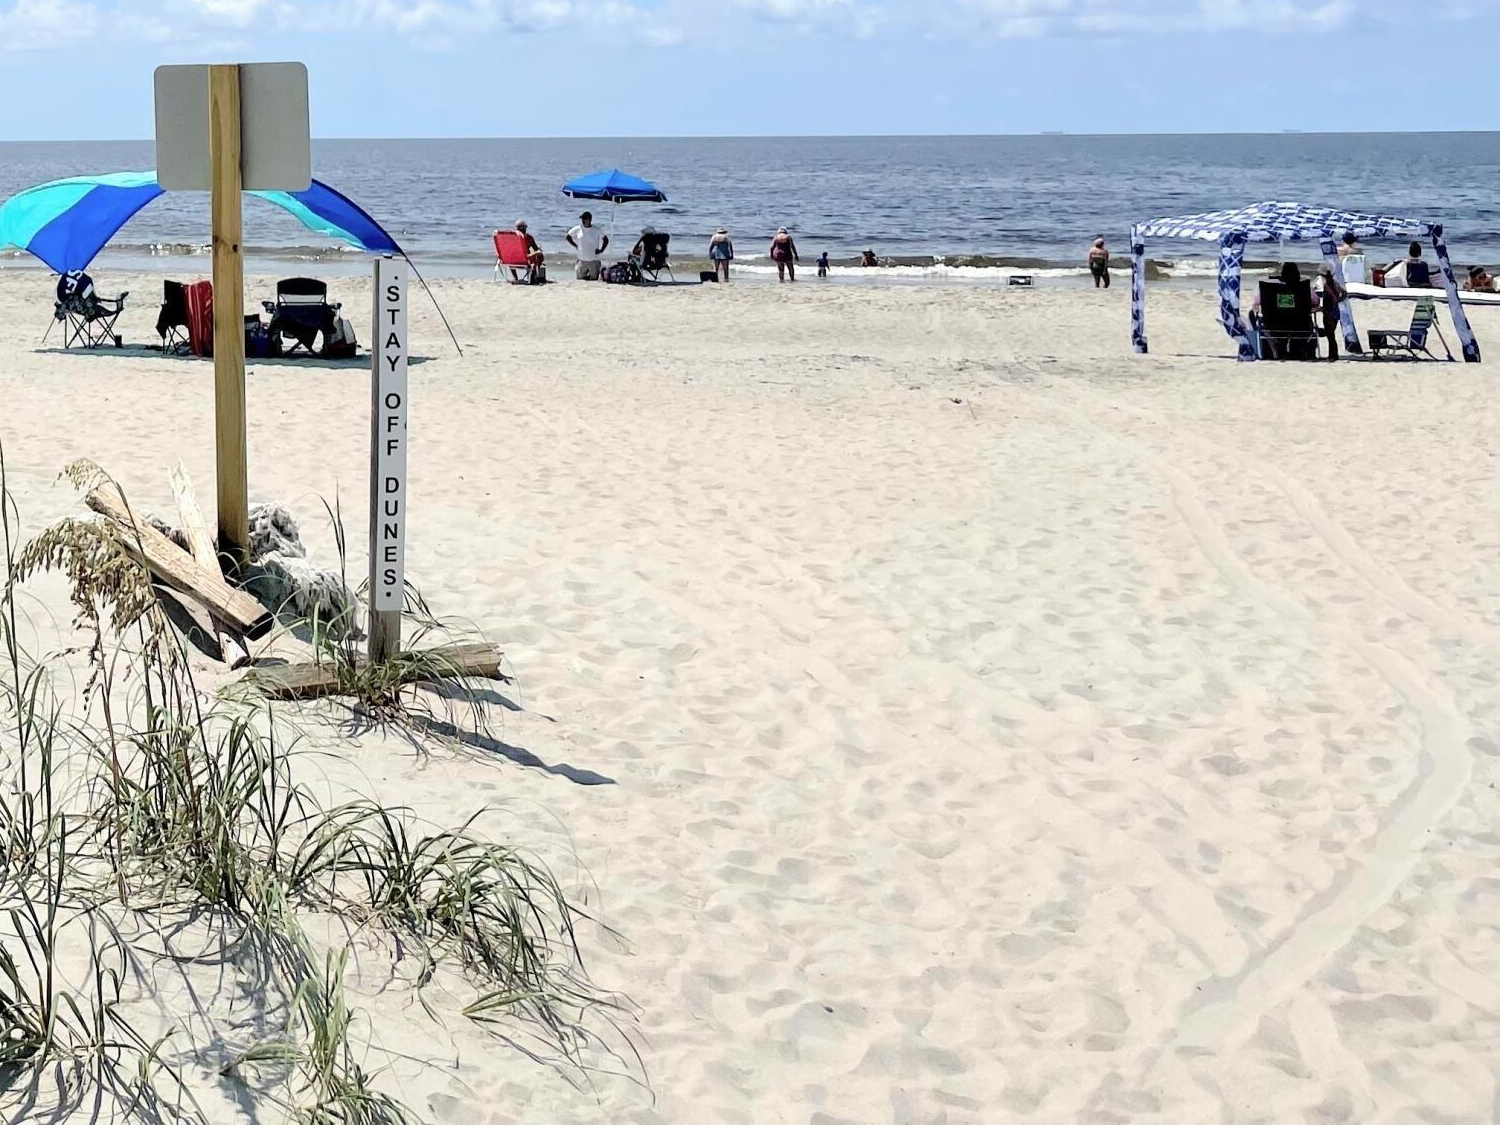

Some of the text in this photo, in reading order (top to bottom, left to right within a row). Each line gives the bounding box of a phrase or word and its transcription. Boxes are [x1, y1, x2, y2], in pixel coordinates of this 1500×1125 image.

[383, 285, 401, 586] STAY OFF DUNES
